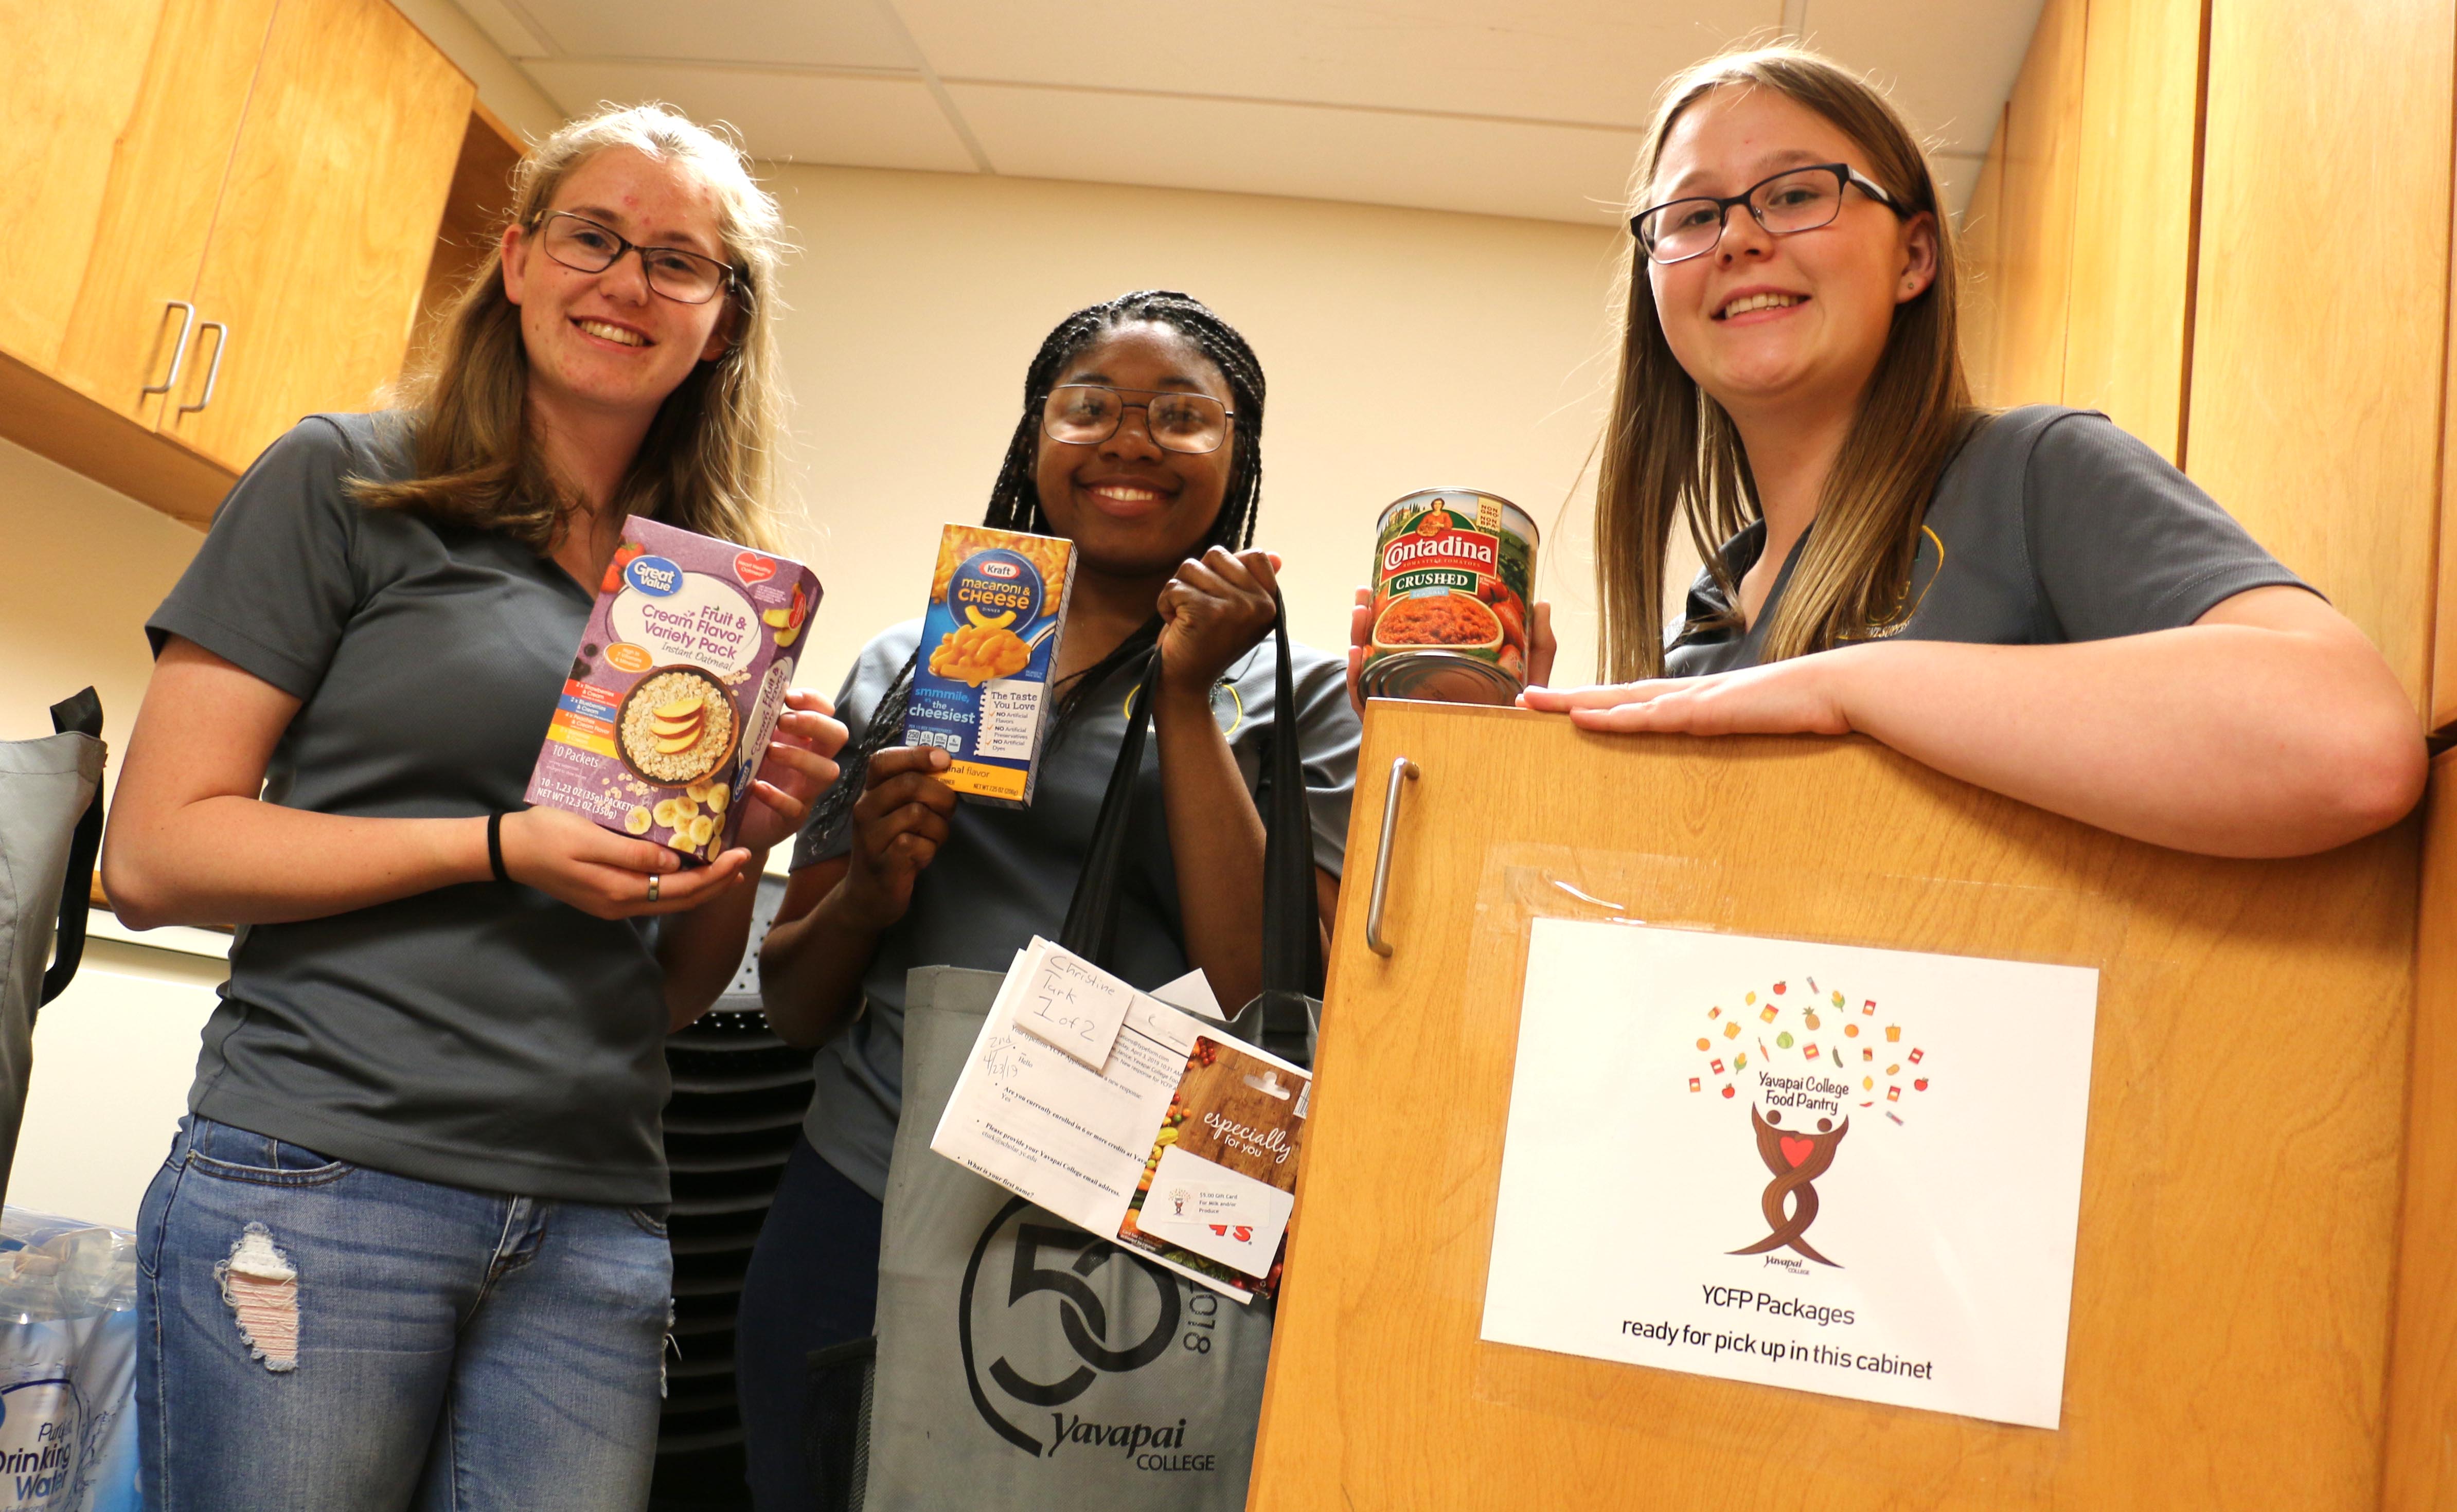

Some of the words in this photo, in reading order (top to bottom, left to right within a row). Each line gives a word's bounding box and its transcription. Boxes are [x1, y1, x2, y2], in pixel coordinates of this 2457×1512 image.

[1481, 505, 1498, 513] NON
[1481, 516, 1497, 525] NON
[1384, 536, 1492, 571] Contadina
[634, 561, 675, 584] Great
[987, 565, 1011, 575] Kraft
[1396, 573, 1468, 590] CRUSHED
[640, 575, 671, 591] Value
[961, 578, 1021, 595] macaroni
[1023, 587, 1030, 596] &
[643, 604, 693, 629] Cream
[697, 619, 743, 644] Flavor
[701, 605, 733, 626] Fruit
[736, 617, 747, 631] &
[645, 620, 696, 649] Variety
[698, 637, 738, 660] Pack
[662, 642, 693, 659] Instant
[695, 652, 735, 671] Oatmeal
[932, 700, 947, 710] the
[991, 691, 1008, 700] The
[1010, 692, 1038, 701] Taste
[994, 701, 1010, 709] You
[1013, 702, 1036, 710] Love
[909, 703, 976, 724] cheesiest
[552, 745, 564, 757] 10
[565, 748, 599, 768] Packets
[967, 766, 990, 778] flavor
[537, 787, 553, 798] NET
[553, 791, 565, 802] WT
[565, 796, 581, 807] 12.3
[582, 802, 593, 811] OZ
[541, 778, 550, 787] 10
[556, 782, 572, 793] 1.23
[572, 787, 583, 795] OZ
[583, 790, 603, 804] (35g)
[603, 797, 635, 812] PACKETS
[1050, 956, 1115, 996] Christine
[989, 1035, 1011, 1048] 2nd
[1059, 1017, 1080, 1029] of
[1080, 1020, 1095, 1042] 2
[984, 1050, 1018, 1079] 4/23/19
[1012, 1024, 1025, 1036] Your
[1025, 1031, 1048, 1049] typeform
[1065, 1054, 1095, 1074] Application
[1108, 1078, 1119, 1087] new
[1018, 1056, 1034, 1068] Hello
[1131, 1048, 1143, 1057] April
[1147, 1057, 1160, 1066] 2019
[1120, 1059, 1131, 1068] New
[1131, 1066, 1152, 1079] response
[1160, 1079, 1173, 1089] YCFP
[1133, 1056, 1151, 1070] Yavapai
[1151, 1067, 1169, 1080] College
[1169, 1076, 1179, 1084] Foo
[1759, 1071, 1804, 1094] Yavapai
[1806, 1076, 1849, 1099] College
[1001, 1093, 1011, 1103] Yes
[1766, 1089, 1795, 1106] Food
[1796, 1093, 1838, 1116] Pantry
[1004, 1087, 1015, 1095] Are
[1015, 1093, 1026, 1102] you
[1026, 1099, 1052, 1115] currently
[1053, 1112, 1076, 1127] enrolled
[1093, 1134, 1108, 1145] more
[1108, 1142, 1126, 1155] credits
[1133, 1154, 1147, 1165] Yava
[1204, 1112, 1292, 1164] especially
[986, 1122, 1003, 1136] Please
[1003, 1133, 1025, 1147] provide
[1024, 1144, 1039, 1154] your
[1040, 1150, 1063, 1167] Yavapai
[1062, 1162, 1083, 1177] College
[1082, 1174, 1099, 1186] email
[1224, 1134, 1240, 1148] for
[1241, 1143, 1262, 1157] you
[967, 1159, 983, 1172] What
[988, 1172, 1003, 1182] your
[1002, 1178, 1016, 1189] first
[1015, 1185, 1035, 1198] name?
[1764, 1255, 1803, 1269] Yavapai
[1183, 1281, 1218, 1354] 018
[1702, 1285, 1753, 1309] YCFP
[1756, 1292, 1855, 1326] Packages
[1622, 1319, 1679, 1346] ready
[1682, 1324, 1712, 1346] for
[1715, 1330, 1757, 1354] pick
[1761, 1340, 1786, 1362] up
[1790, 1340, 1808, 1362] in
[1813, 1344, 1851, 1368] this
[1856, 1353, 1933, 1380] cabinet
[1047, 1412, 1187, 1459] Yavapai
[1136, 1454, 1216, 1472] COLLEGE
[16, 1469, 68, 1501] Water
